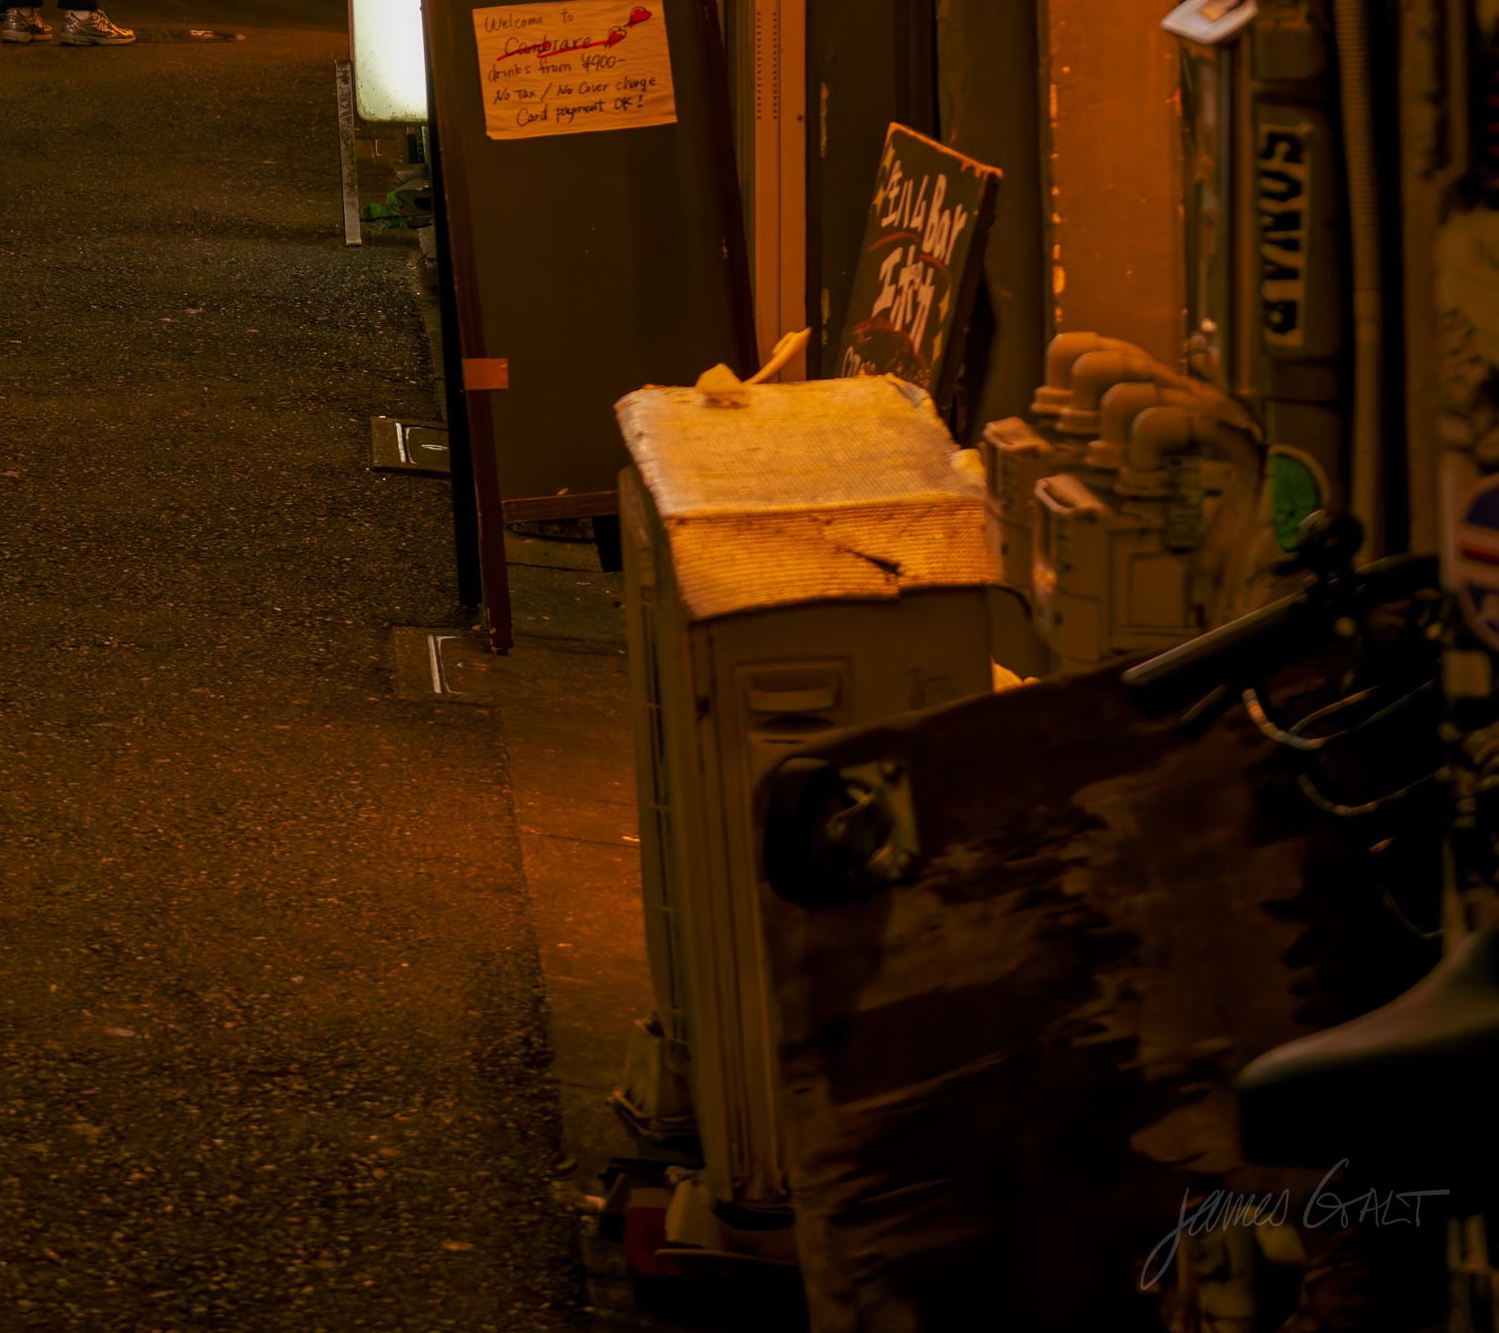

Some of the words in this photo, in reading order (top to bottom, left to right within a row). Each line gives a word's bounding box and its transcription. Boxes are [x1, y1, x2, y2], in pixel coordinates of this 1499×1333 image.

[484, 13, 545, 33] Welcome
[560, 8, 574, 24] to
[487, 63, 531, 83] drinks
[538, 58, 572, 73] from
[493, 87, 510, 104] No
[514, 89, 536, 99] Tax
[556, 83, 573, 96] No
[578, 81, 610, 95] Cover
[616, 75, 657, 93] charge
[516, 103, 548, 127] Card
[555, 100, 605, 123] payment
[614, 94, 644, 110] OK!
[881, 159, 930, 233] 生ハム
[922, 173, 968, 266] Bar
